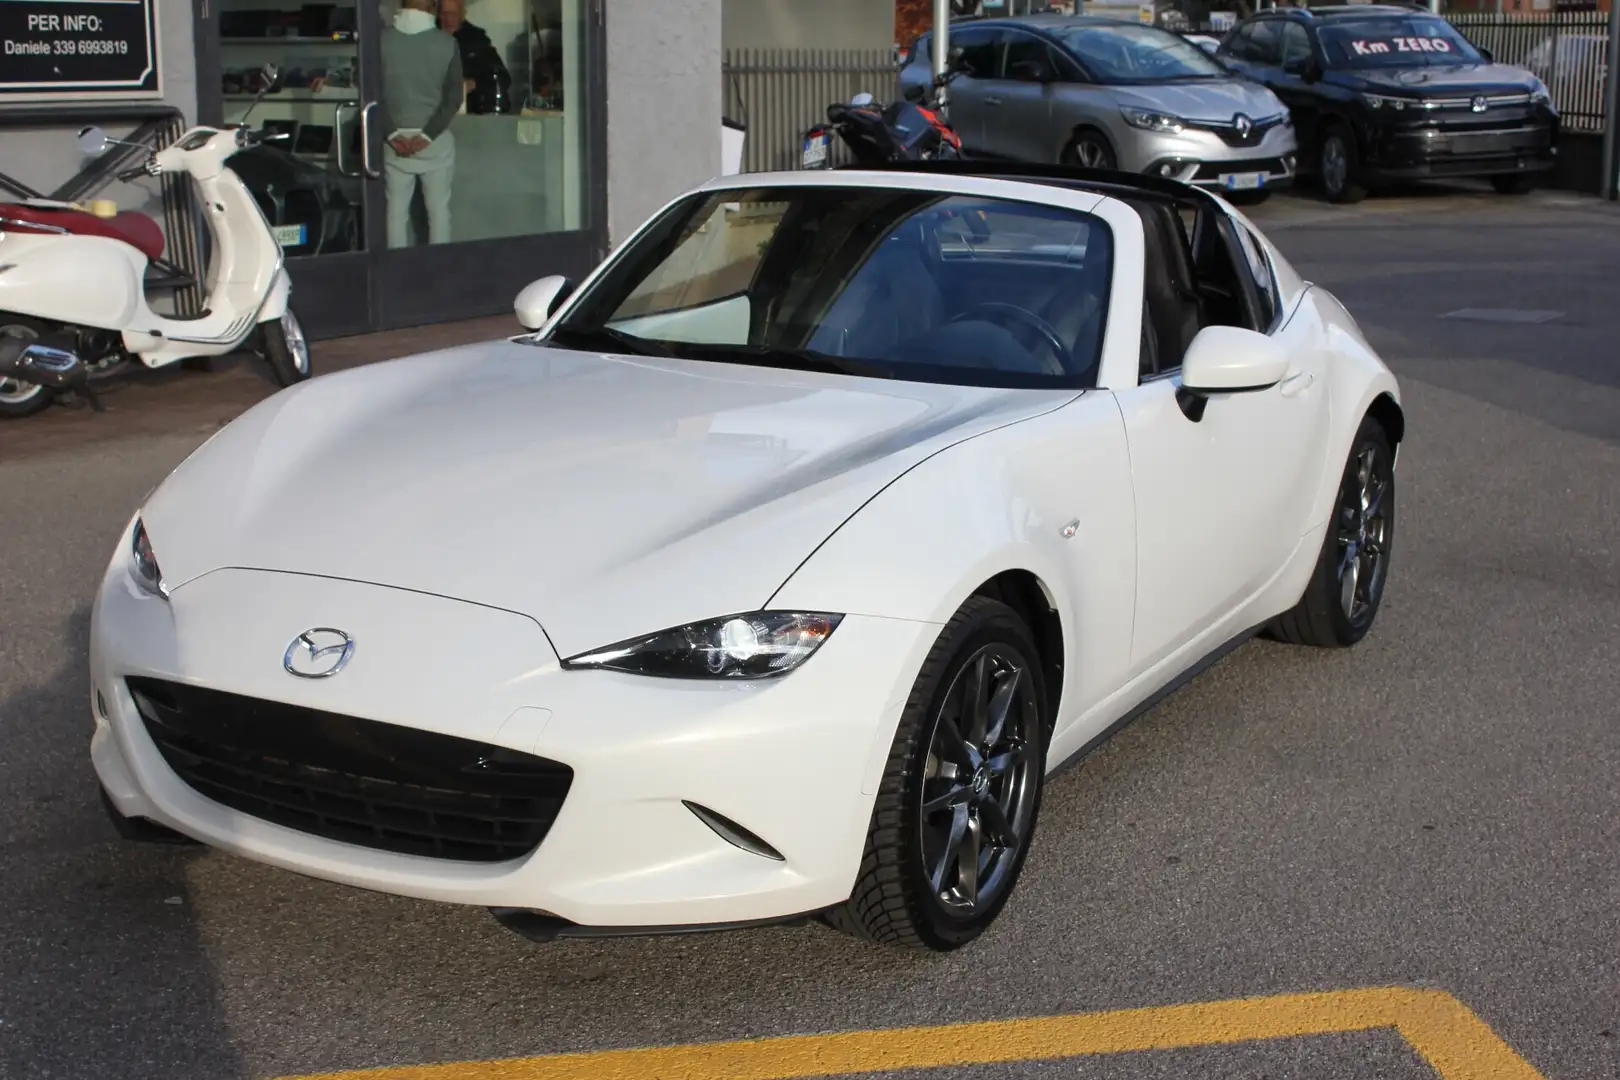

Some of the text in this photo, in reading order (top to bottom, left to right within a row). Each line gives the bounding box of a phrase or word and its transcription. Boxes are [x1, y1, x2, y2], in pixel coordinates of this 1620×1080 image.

[28, 14, 103, 31] PER INFO:
[4, 40, 128, 55] Daniele 339 6993819
[1351, 37, 1450, 55] Km ZERO
